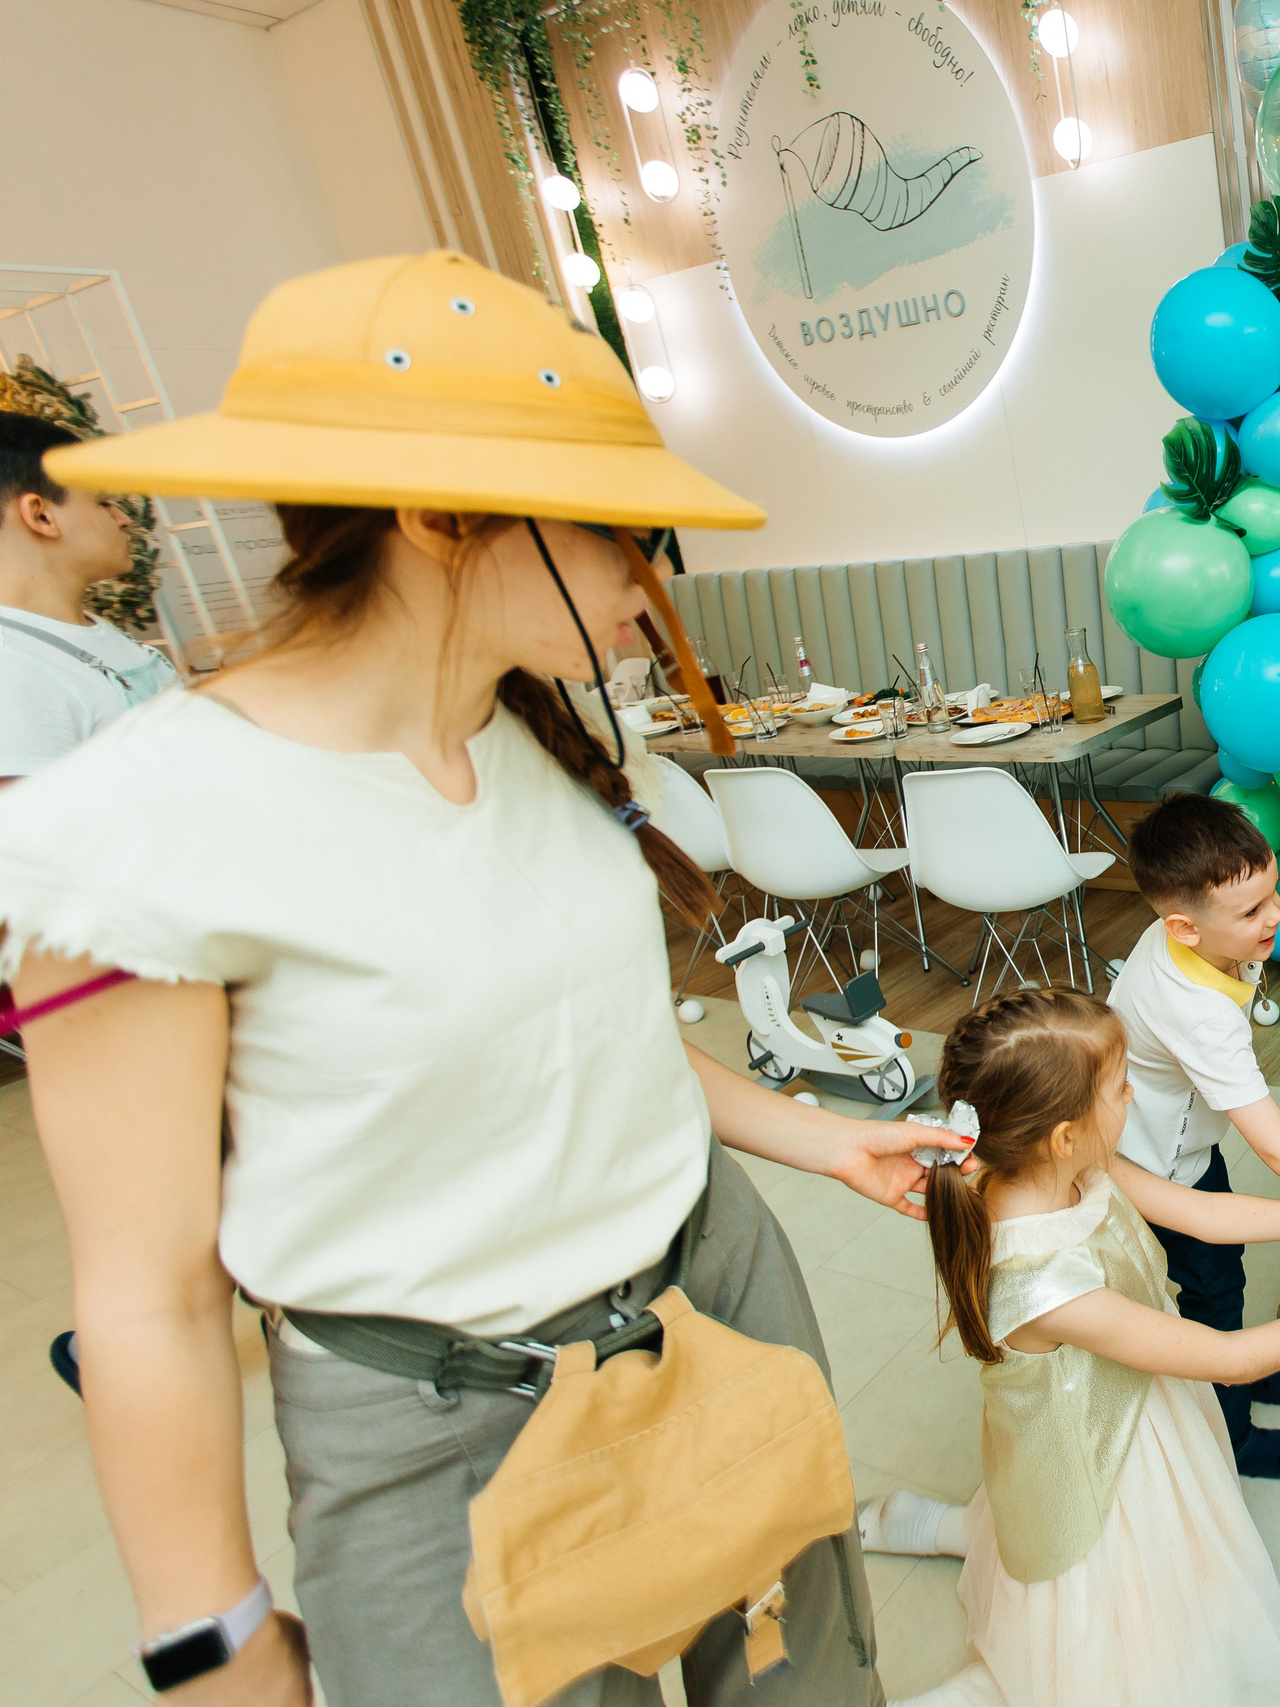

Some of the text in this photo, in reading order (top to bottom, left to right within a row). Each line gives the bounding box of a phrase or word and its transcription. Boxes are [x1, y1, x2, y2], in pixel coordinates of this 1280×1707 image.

[727, 51, 771, 160] Родителям
[832, 0, 887, 27] детям
[908, 13, 975, 87] свободно!
[799, 289, 967, 346] ВОЗДУШНО
[768, 323, 799, 370] Детское
[803, 374, 837, 401] игровое
[846, 399, 914, 423] пространство
[938, 348, 981, 396] семейный
[982, 274, 1010, 345] ресторан
[1180, 1117, 1188, 1136] LACOSTE
[1187, 1091, 1195, 1111] LACOSTE
